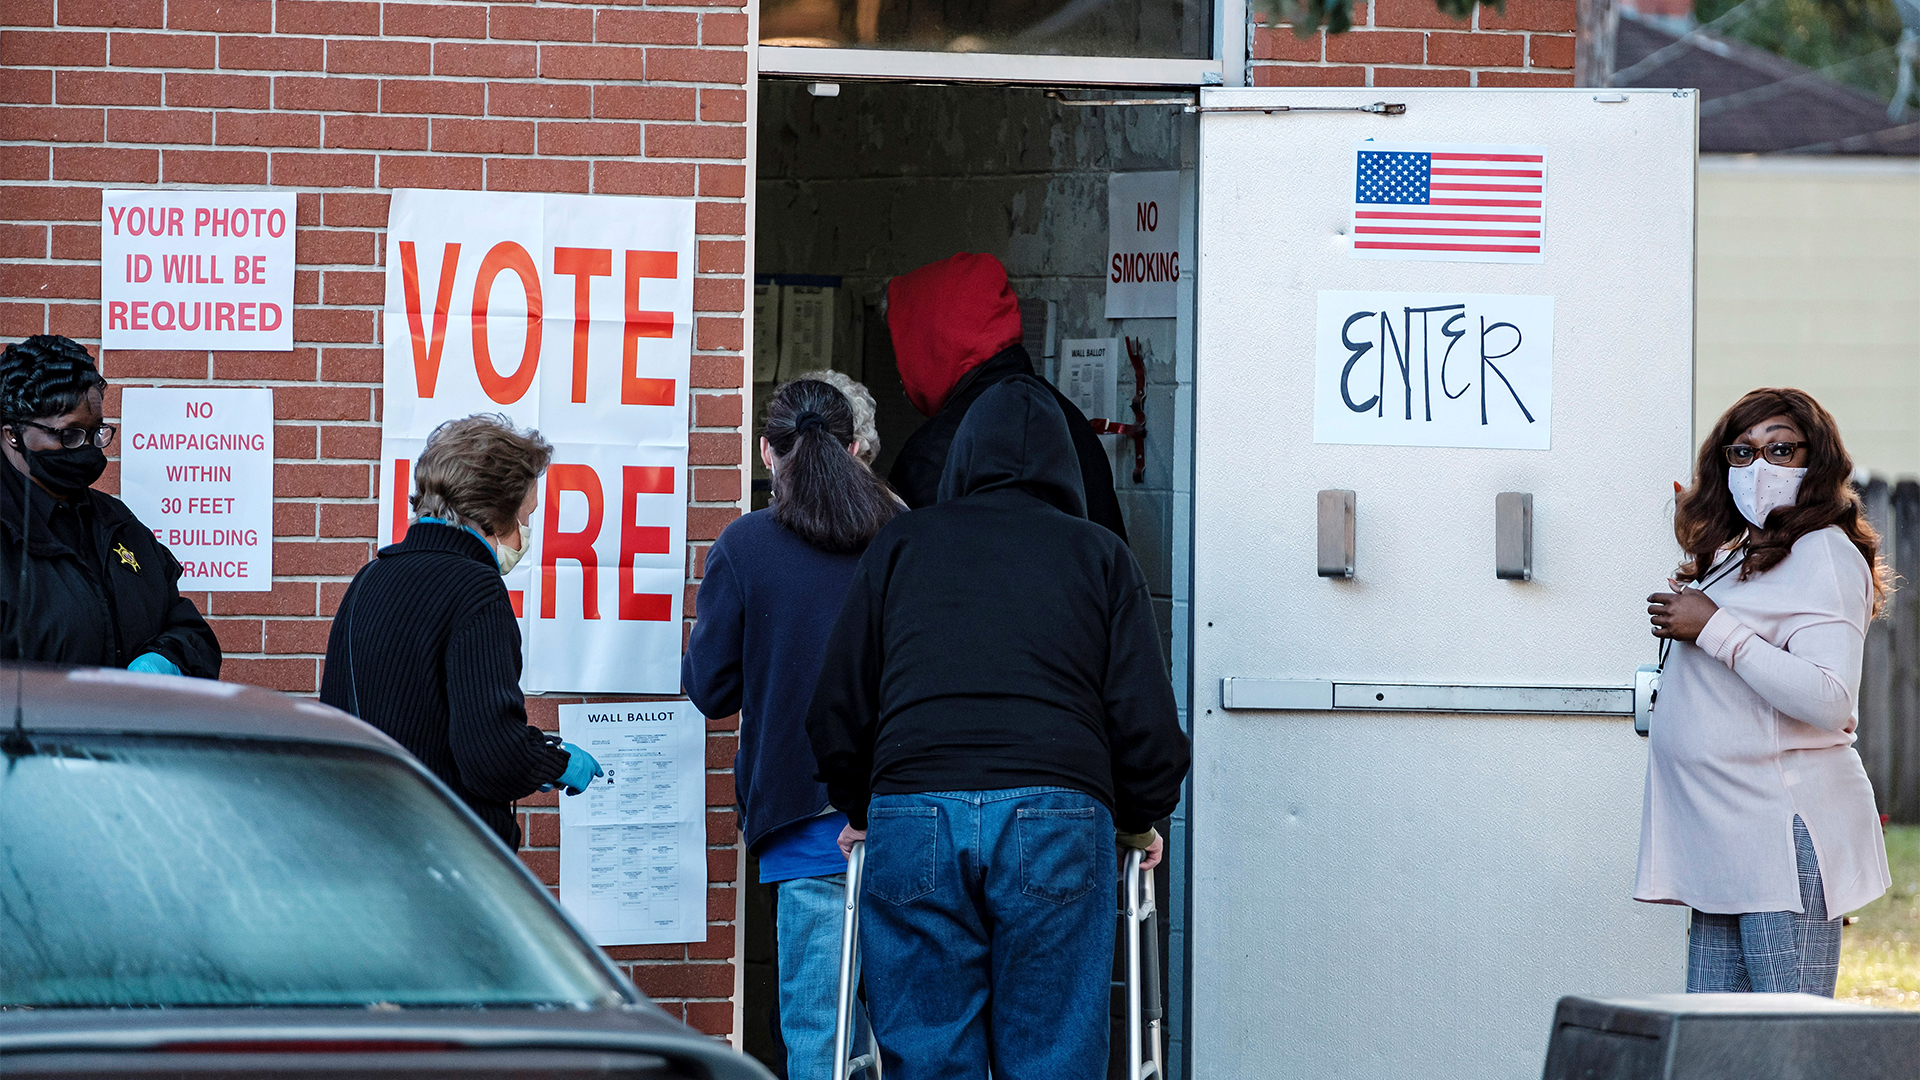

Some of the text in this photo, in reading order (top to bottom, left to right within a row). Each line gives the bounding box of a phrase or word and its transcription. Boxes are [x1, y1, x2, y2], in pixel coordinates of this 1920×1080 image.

[108, 206, 287, 239] YOUR PHOTO
[1136, 201, 1159, 232] NO
[126, 253, 267, 286] ID WILL BE
[1111, 251, 1180, 284] SMOKING
[108, 300, 283, 333] REQUIRED
[399, 240, 679, 406] VOTE
[1071, 348, 1106, 357] WALL BALLOT
[1340, 303, 1535, 426] ENTER
[186, 401, 214, 419] NO
[132, 433, 265, 452] CAMPAIGNING
[166, 465, 232, 483] WITHIN
[161, 497, 236, 514] 30 FEET
[169, 529, 258, 547] BUILDING
[392, 459, 675, 622] RE
[179, 561, 248, 578] RANCE
[588, 711, 675, 723] WALL BALLOT
